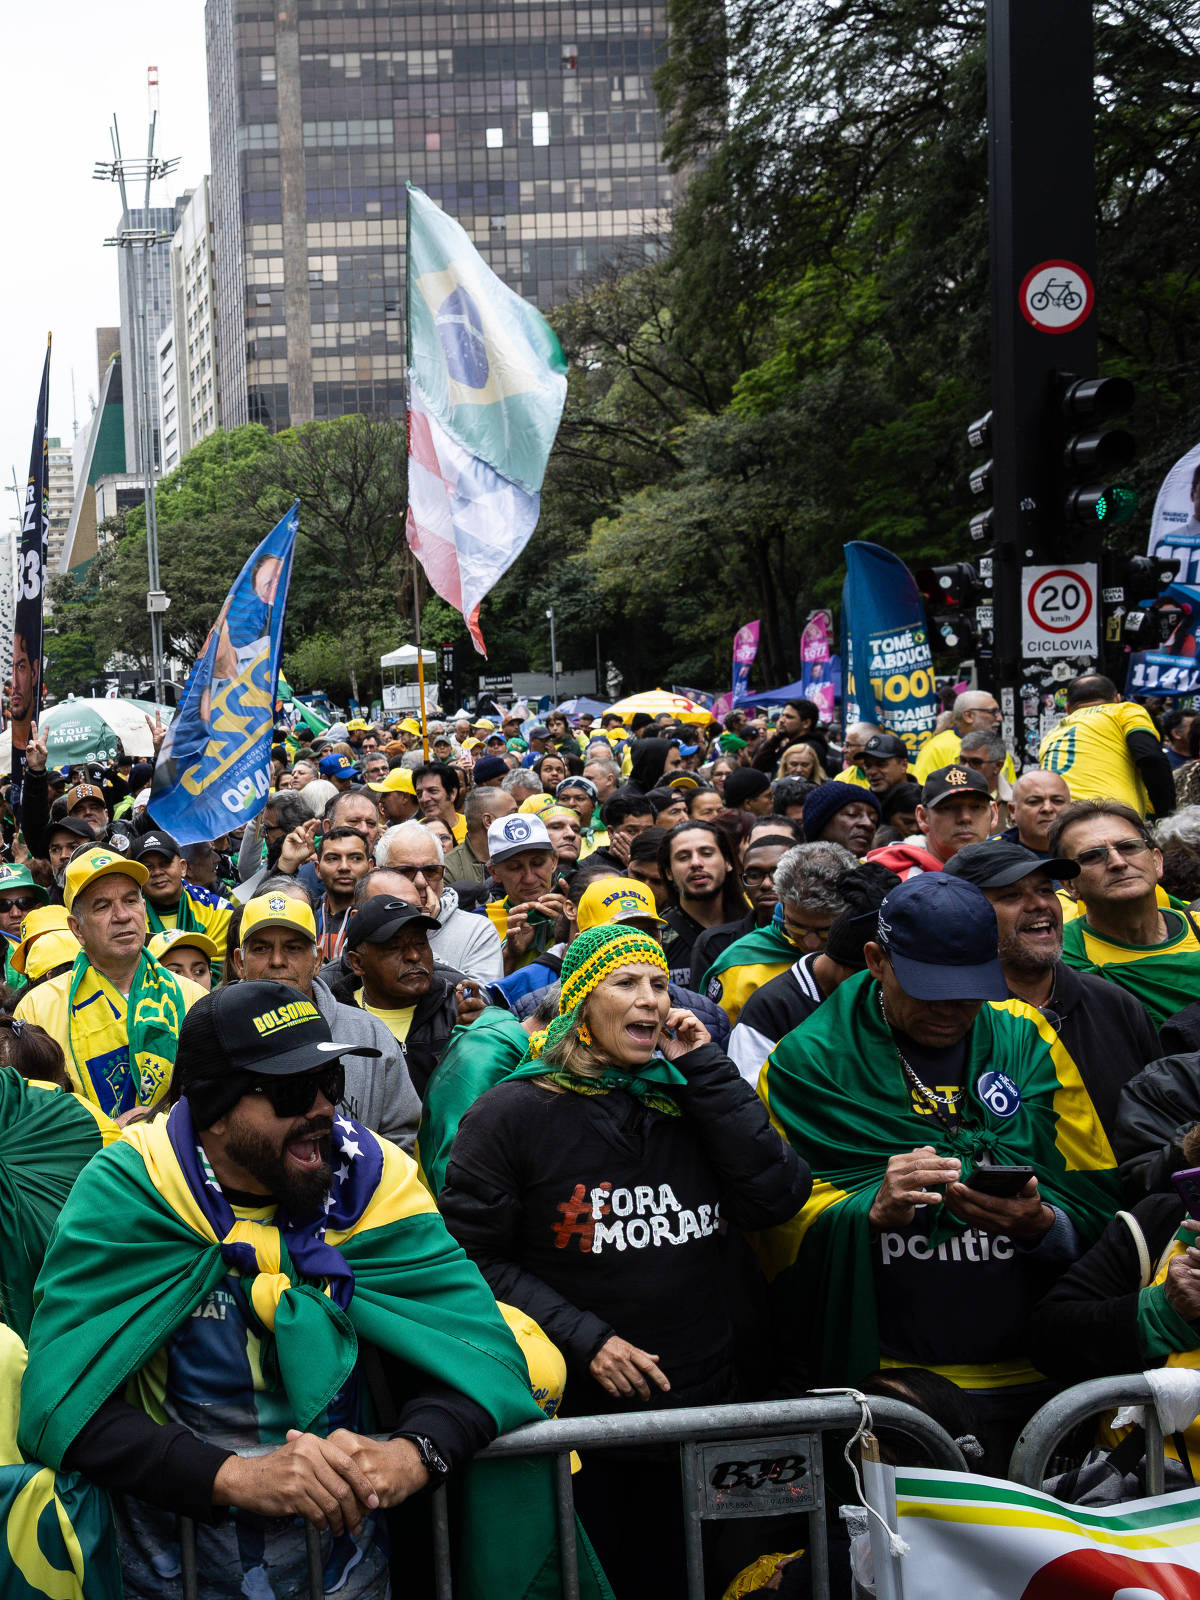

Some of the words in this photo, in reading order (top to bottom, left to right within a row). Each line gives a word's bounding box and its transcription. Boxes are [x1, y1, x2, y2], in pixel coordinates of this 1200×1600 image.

[1040, 584, 1081, 612] 20
[1051, 614, 1071, 623] km/h
[869, 630, 914, 655] TOMÉ
[1027, 639, 1093, 652] CICLOVIA
[870, 644, 932, 670] ABDUCH
[869, 667, 937, 702] 1001
[53, 733, 89, 744] MATE
[510, 827, 527, 840] 10
[602, 890, 648, 907] BRASIL
[984, 1084, 1008, 1112] 10
